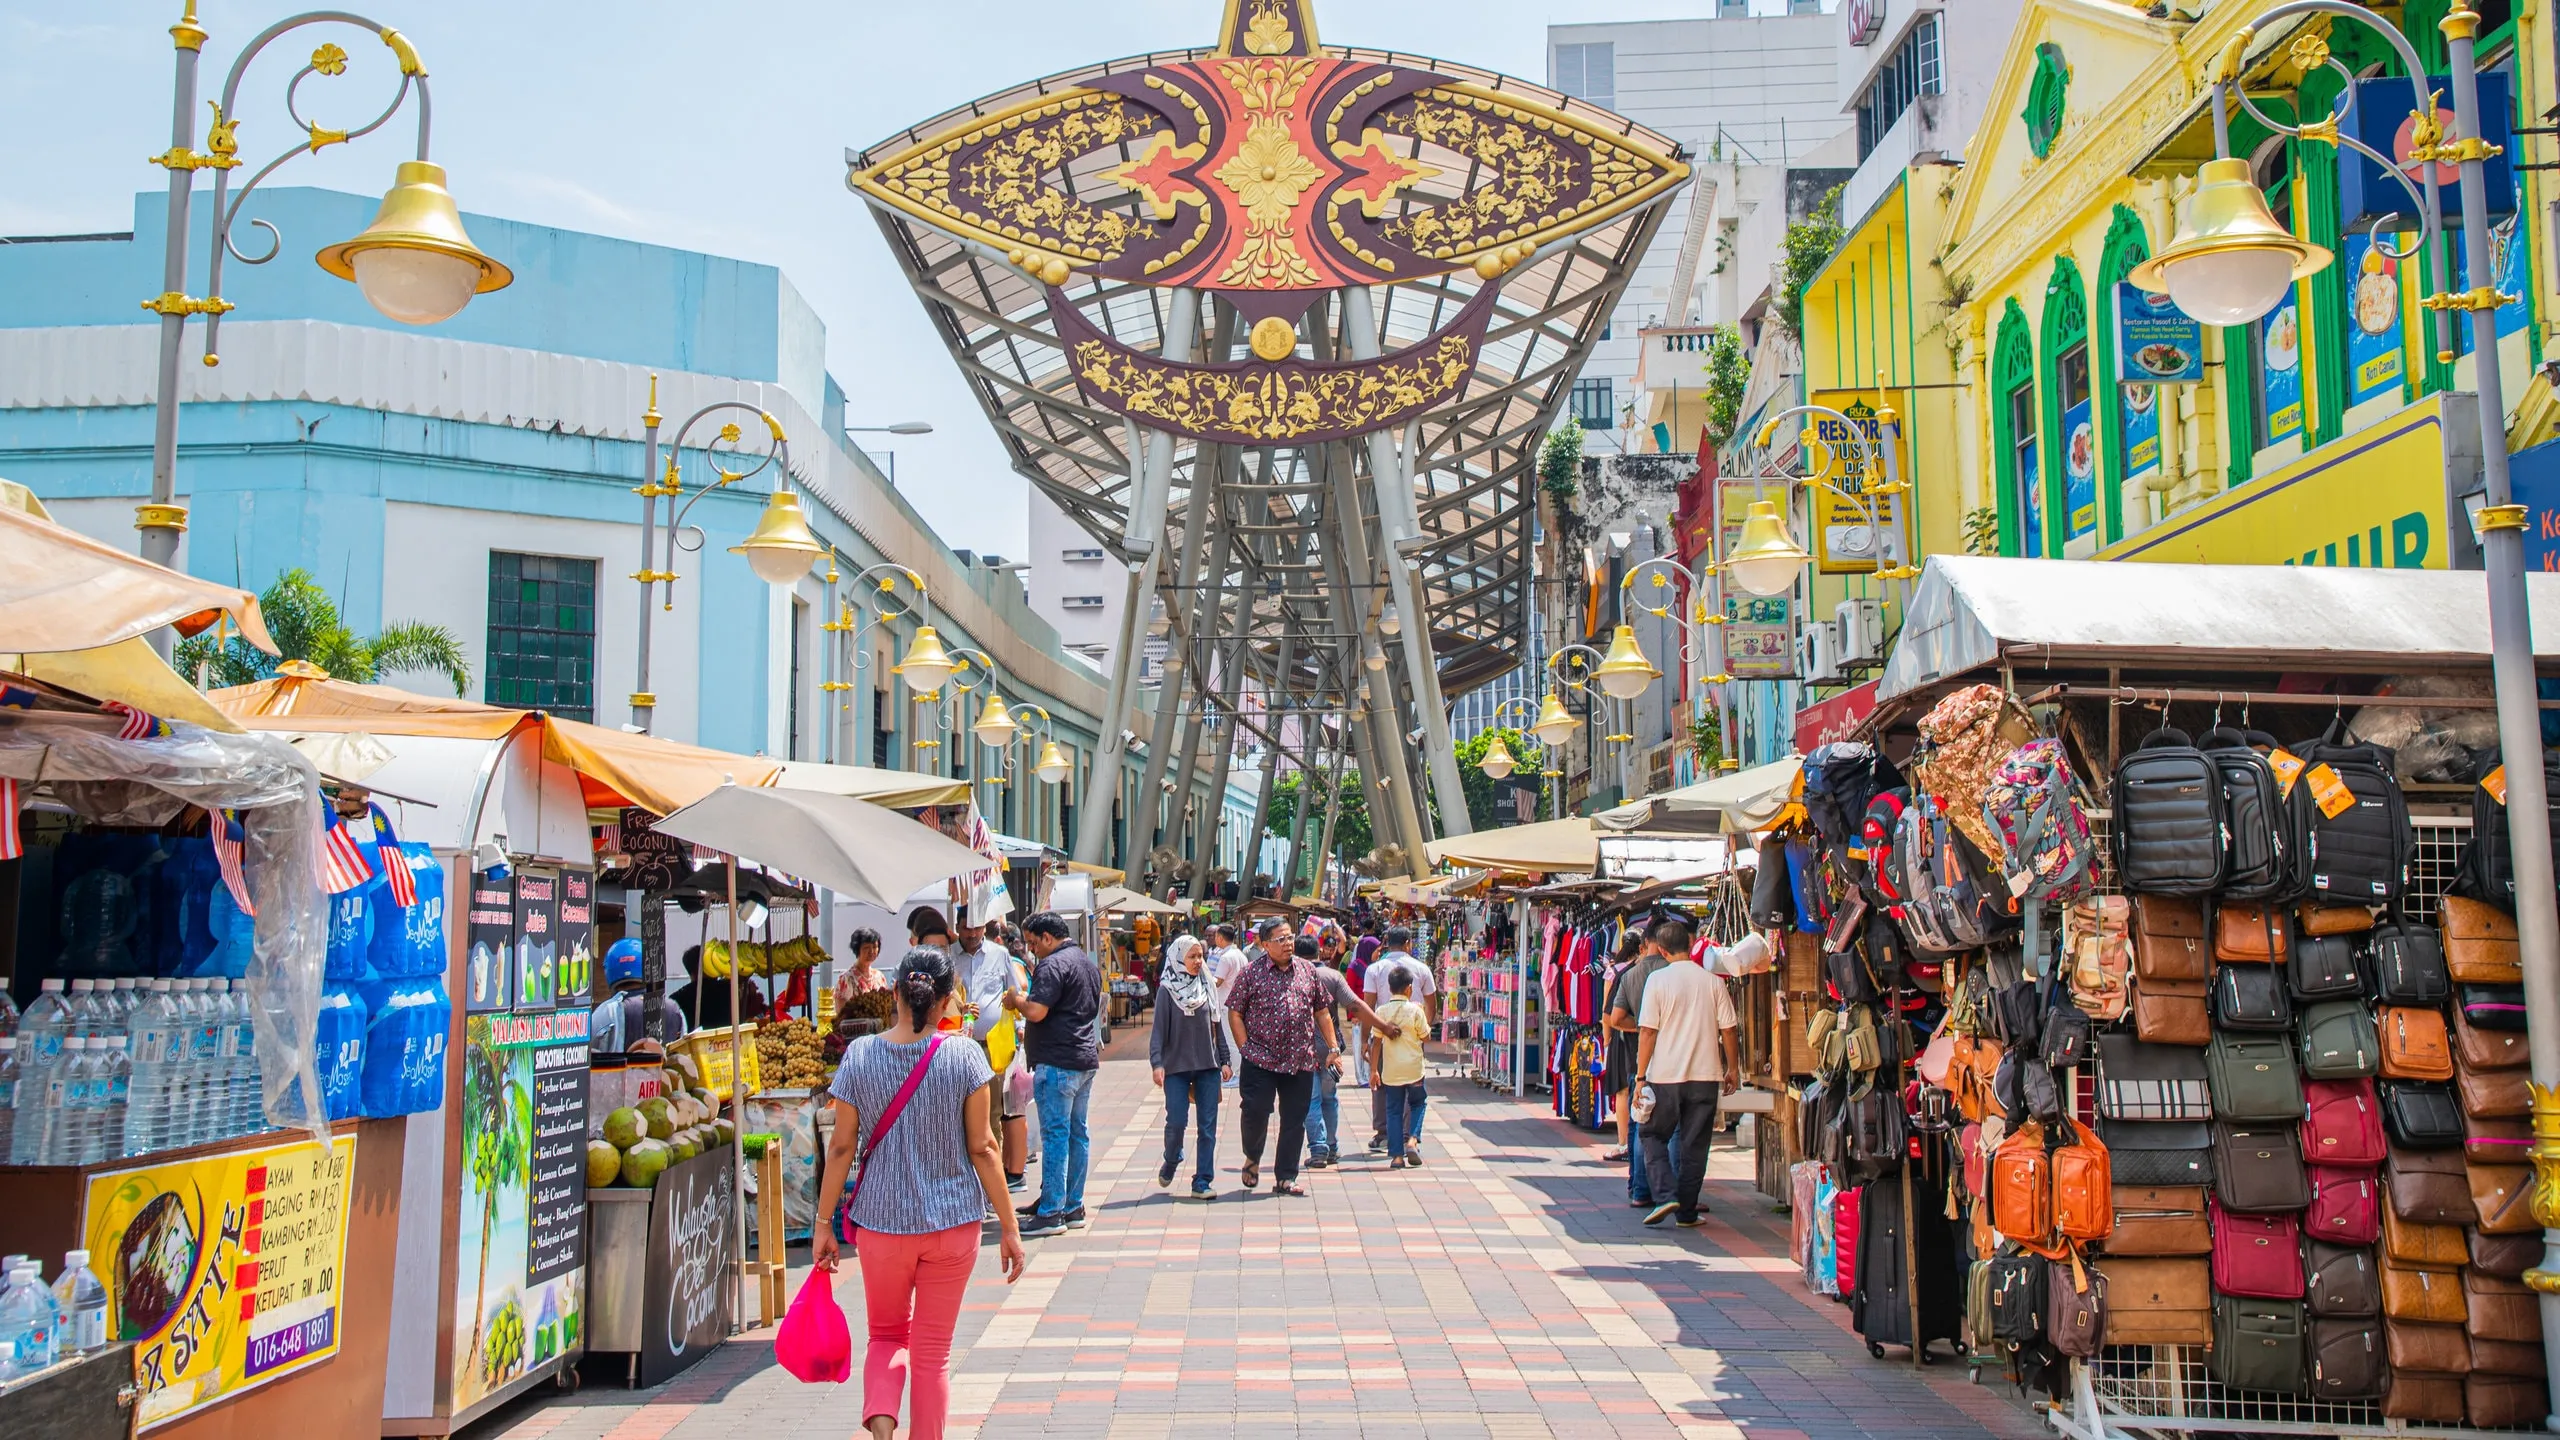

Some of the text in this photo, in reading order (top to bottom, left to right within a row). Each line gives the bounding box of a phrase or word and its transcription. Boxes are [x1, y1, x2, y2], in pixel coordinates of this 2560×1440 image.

[2366, 354, 2396, 382] Roti Canai
[1849, 407, 1869, 417] RYZ
[2277, 415, 2290, 430] Fried
[1818, 418, 1901, 441] RESTORN
[620, 833, 676, 851] COCONUT
[1305, 824, 1313, 852] Laluan
[519, 875, 553, 900] Coconut
[567, 875, 588, 899] Fresh
[525, 908, 547, 933] Juice
[561, 899, 590, 924] Coconut
[491, 1011, 589, 1045] MALAYSIA BEST COCONUT
[535, 1045, 589, 1070] SMOOTHIE COCONUT
[541, 1076, 578, 1097] Lychee Coconut
[638, 1080, 655, 1099] AIR
[541, 1097, 583, 1117] Pineapple Coconut
[540, 1118, 584, 1138] Rambutan Coconut
[539, 1142, 573, 1160] Kiwi Coconut
[267, 1167, 293, 1191] AYAM
[538, 1162, 577, 1182] Lemon Coconut
[264, 1192, 303, 1221] DAGING
[538, 1184, 572, 1205] Bali Coconut
[537, 1212, 552, 1228] Bang
[556, 1206, 570, 1222] Bang
[668, 1173, 721, 1266] Malaysia
[260, 1220, 305, 1252] KAMBING
[536, 1224, 579, 1249] Malaysia Coconut
[258, 1255, 288, 1282] PERUT
[535, 1244, 574, 1272] Coconut Shake
[255, 1282, 295, 1314] KETUPAT
[668, 1263, 719, 1357] Coconut
[253, 1315, 331, 1368] 016-648 1891
